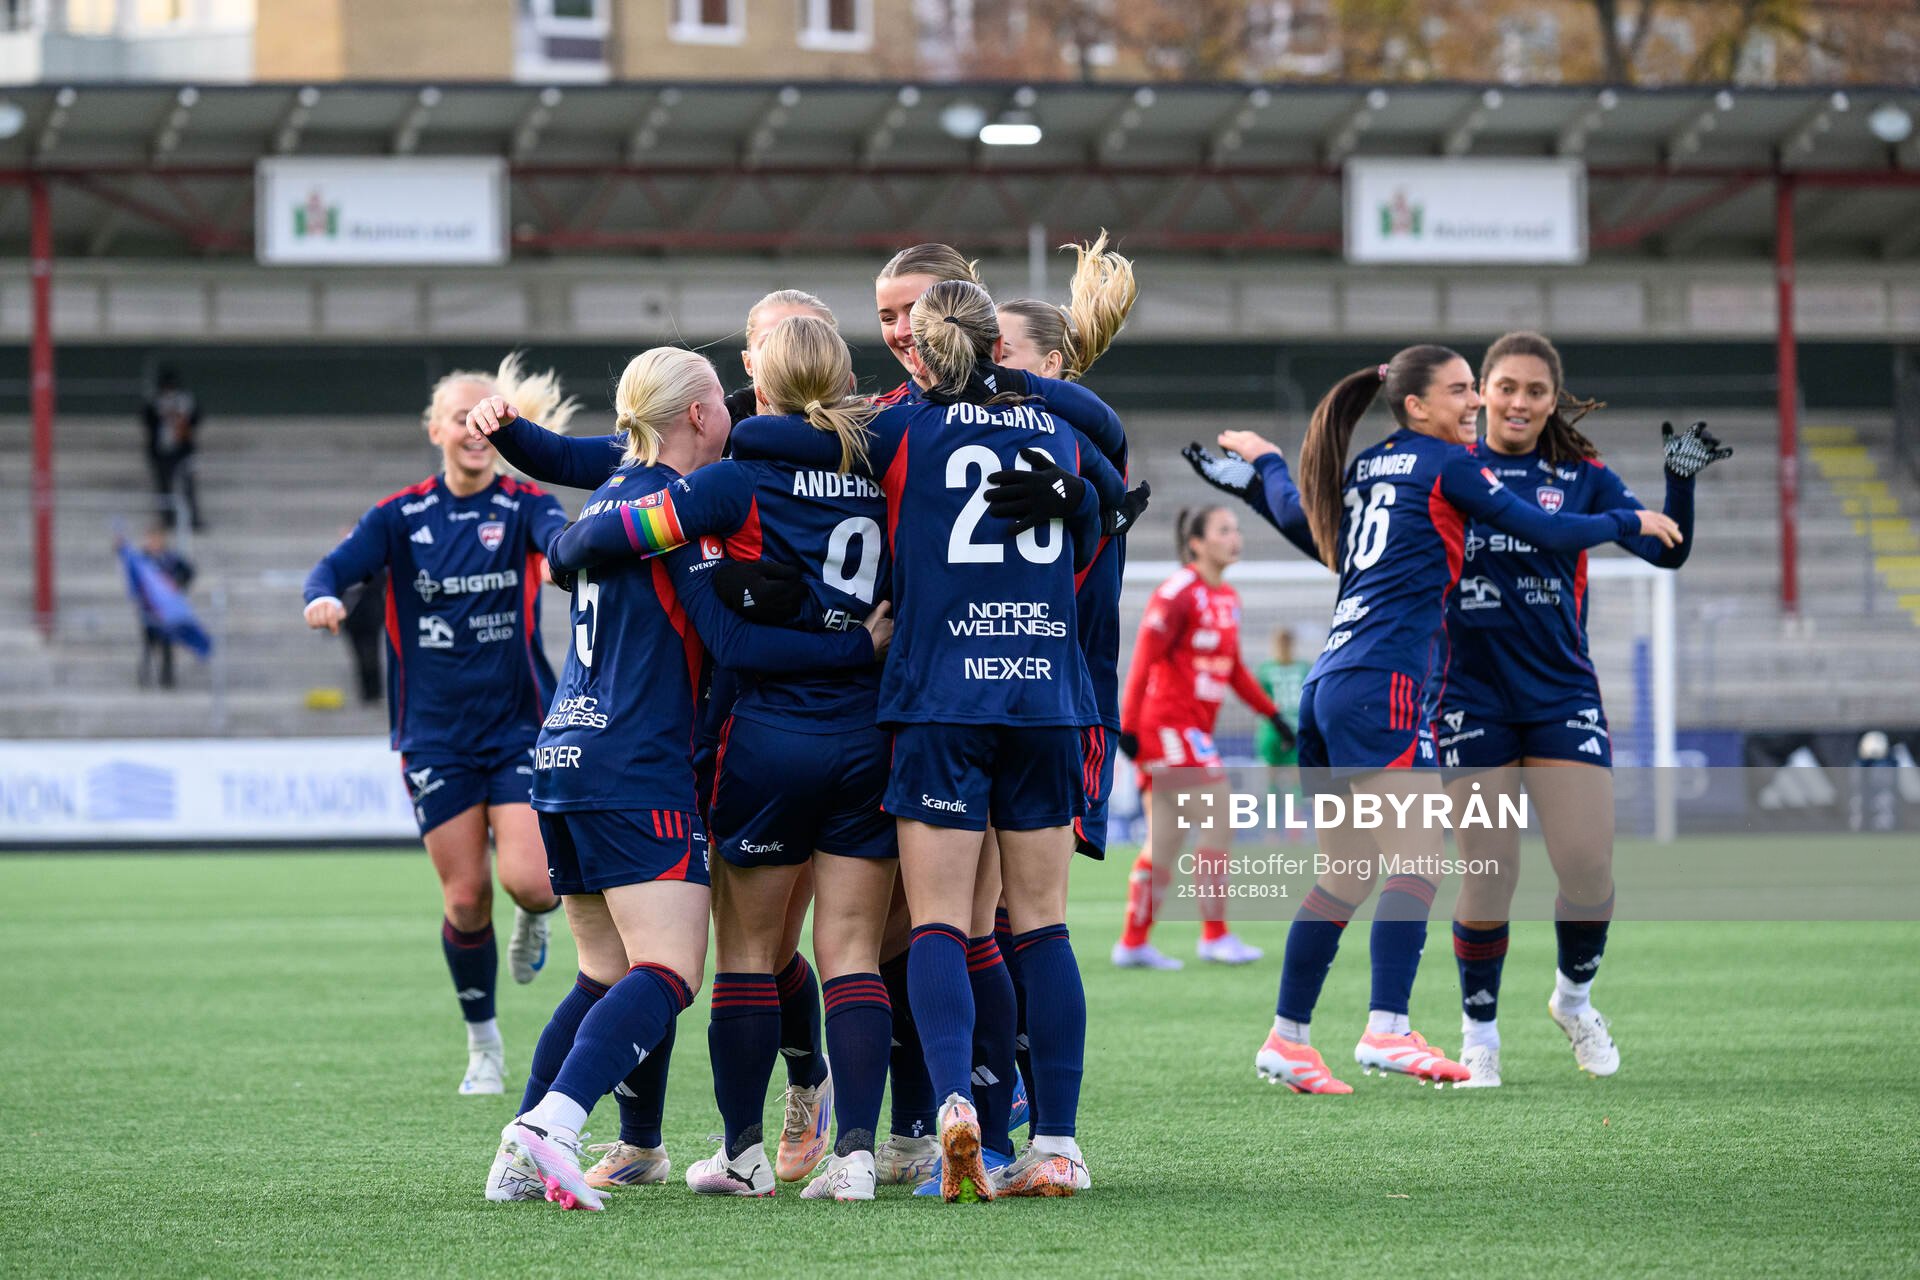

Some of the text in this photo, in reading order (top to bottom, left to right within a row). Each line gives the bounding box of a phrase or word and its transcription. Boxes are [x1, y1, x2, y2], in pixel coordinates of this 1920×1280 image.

[1343, 482, 1396, 573] 16
[689, 560, 719, 573] SVENSK
[969, 602, 1049, 619] NORDIC
[948, 619, 1066, 638] WELLNESS
[964, 657, 1052, 680] NEXER
[534, 746, 582, 770] NEXER
[922, 794, 967, 813] Scandic
[740, 839, 784, 853] Scandic
